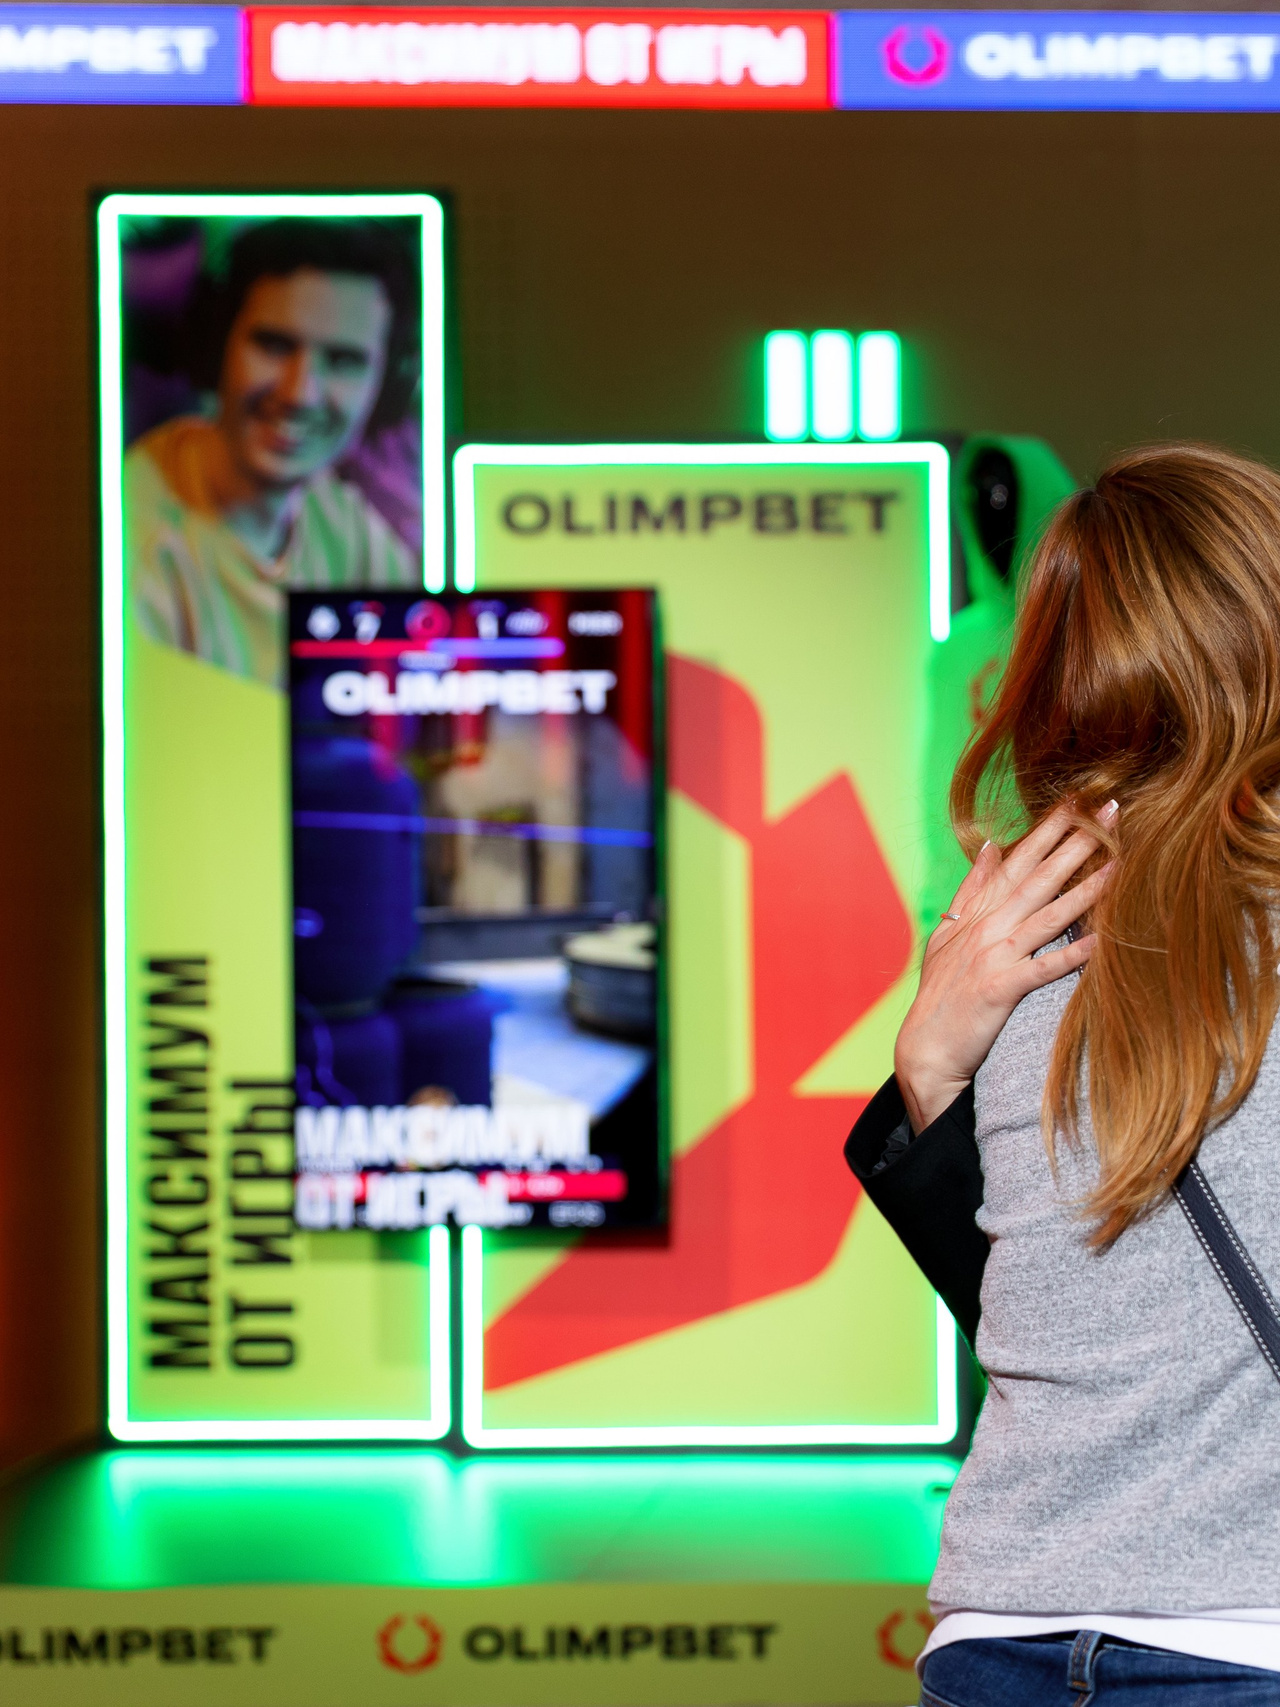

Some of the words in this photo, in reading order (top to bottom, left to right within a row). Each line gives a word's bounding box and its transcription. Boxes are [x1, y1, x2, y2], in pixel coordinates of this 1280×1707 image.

[502, 489, 900, 538] OLIMPBET
[322, 670, 617, 716] OLIMPBET
[145, 953, 212, 1370] МАКСИМУМ
[230, 1078, 296, 1265] ИГРЫ
[229, 1292, 296, 1369] ОТ
[0, 1625, 276, 1666] LIMPBET
[462, 1622, 780, 1664] OLIMPBET
